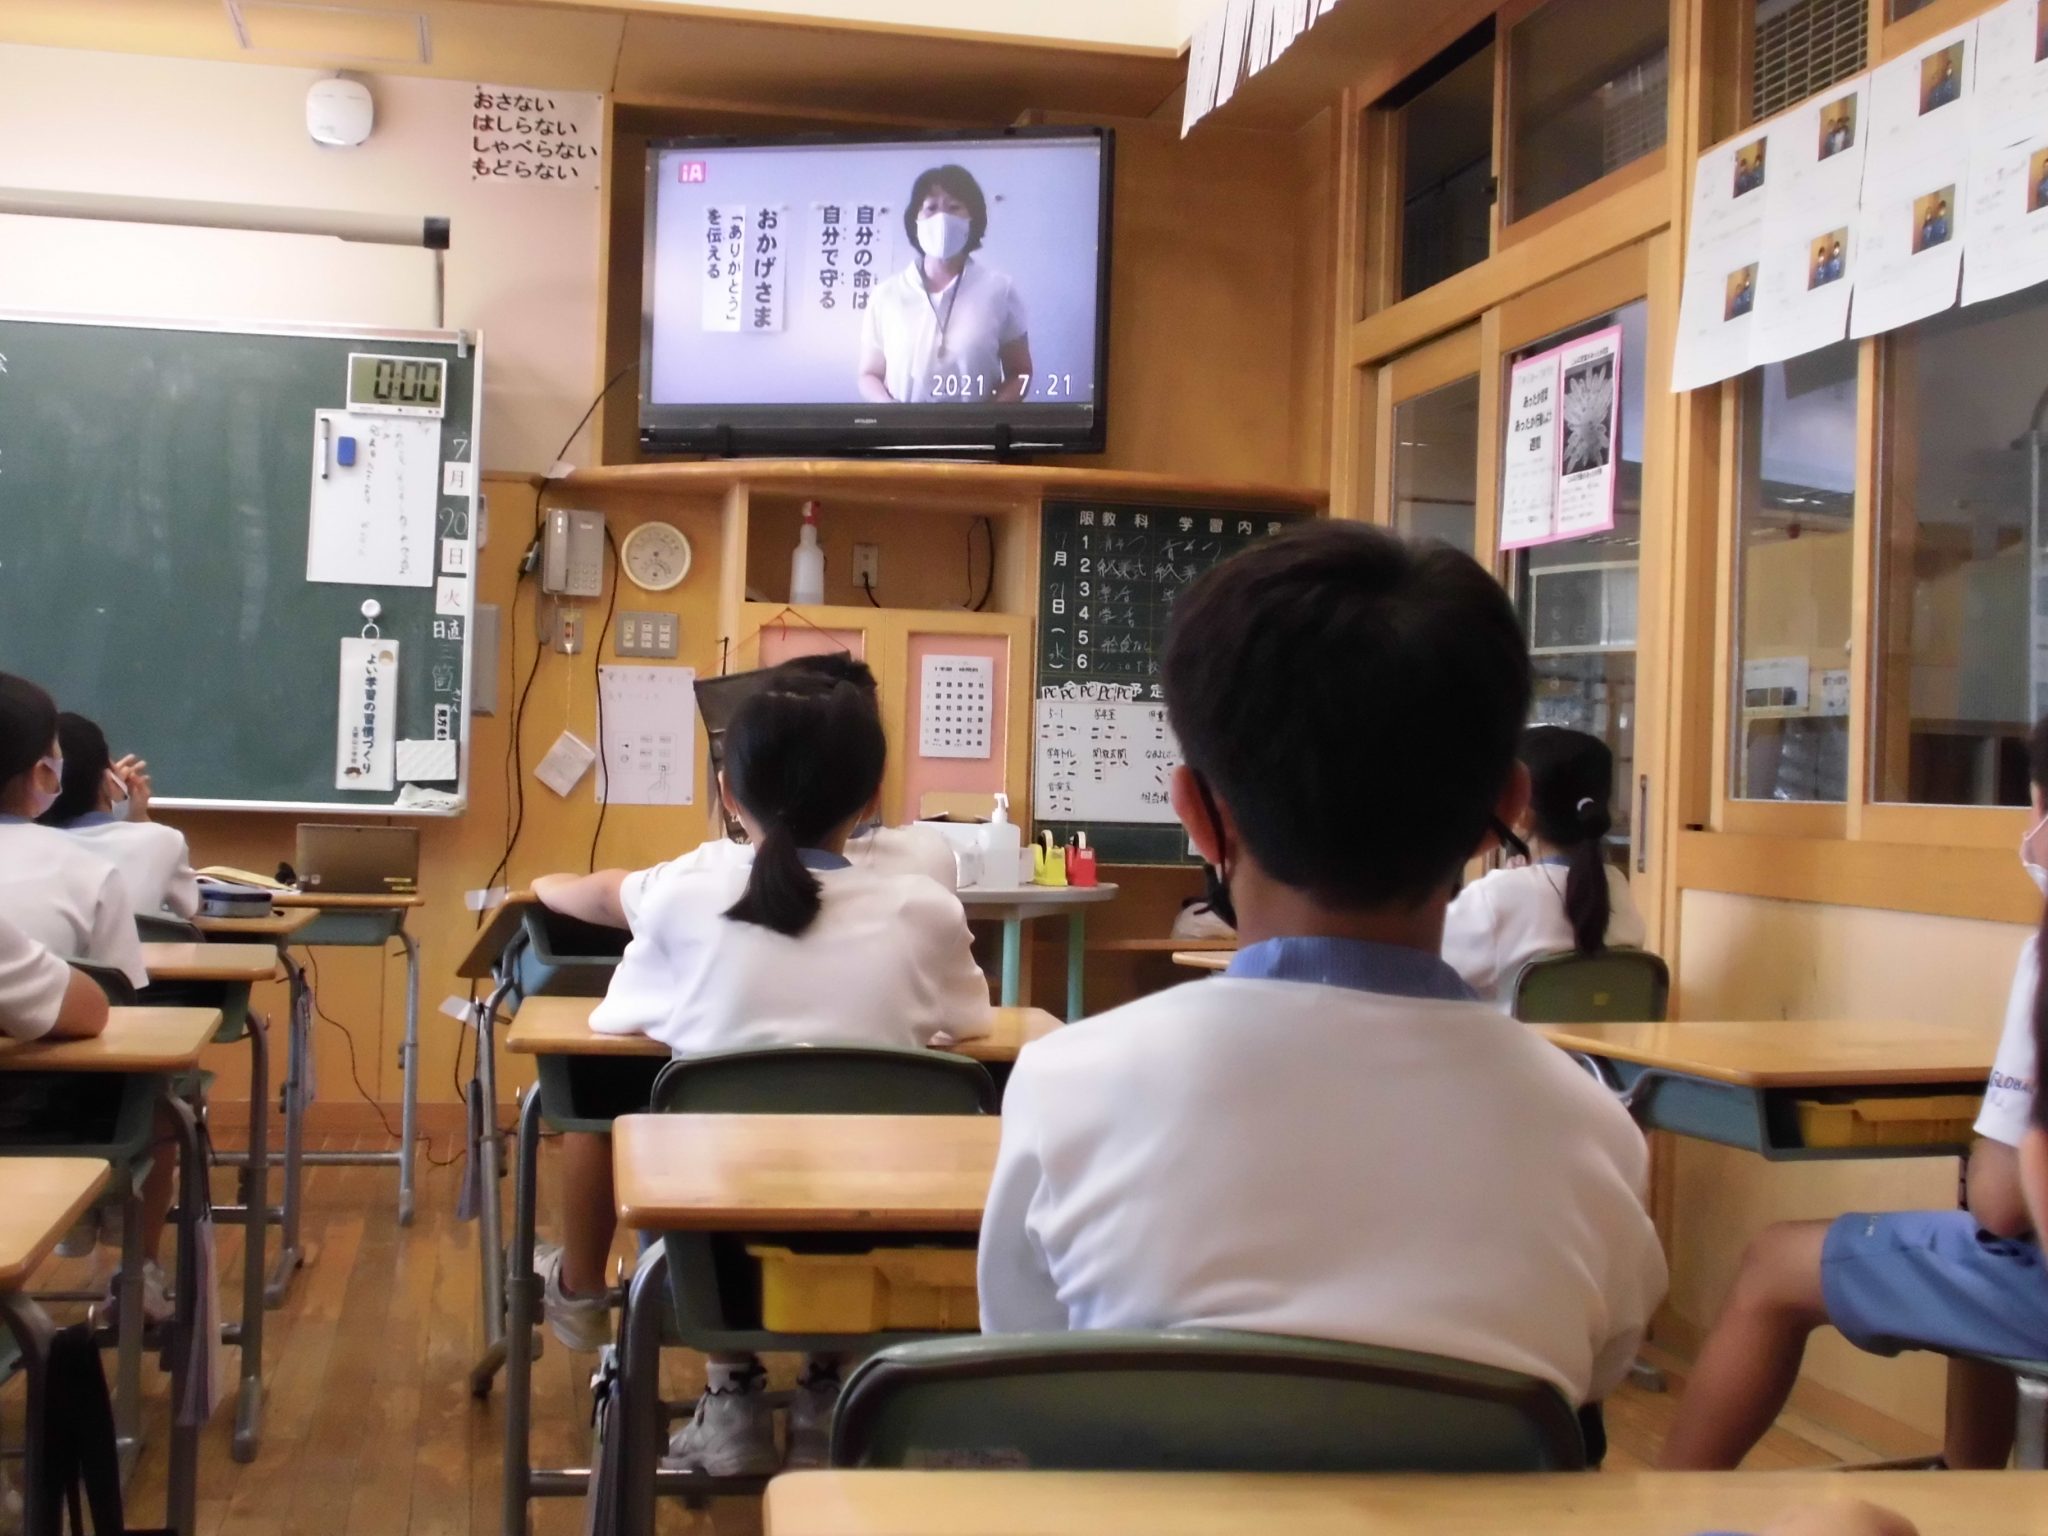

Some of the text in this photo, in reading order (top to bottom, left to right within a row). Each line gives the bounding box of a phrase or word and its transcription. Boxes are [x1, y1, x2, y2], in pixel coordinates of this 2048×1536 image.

[473, 92, 555, 112] おさない
[473, 114, 578, 136] はしらない
[473, 136, 598, 159] しゃべらない
[472, 158, 579, 180] もどらない
[707, 208, 721, 279] を伝える
[820, 205, 841, 309] 自分で守る
[852, 206, 874, 310] 自分の命は
[754, 208, 778, 328] おかげさま
[374, 359, 441, 402] 0:00
[1080, 510, 1094, 526] 限
[1082, 535, 1089, 550] 1
[1080, 557, 1091, 573] 2
[1079, 581, 1090, 597] 3
[1078, 605, 1090, 620] 4
[433, 620, 462, 640] 日直
[1078, 629, 1089, 645] 5
[1077, 653, 1088, 669] 6
